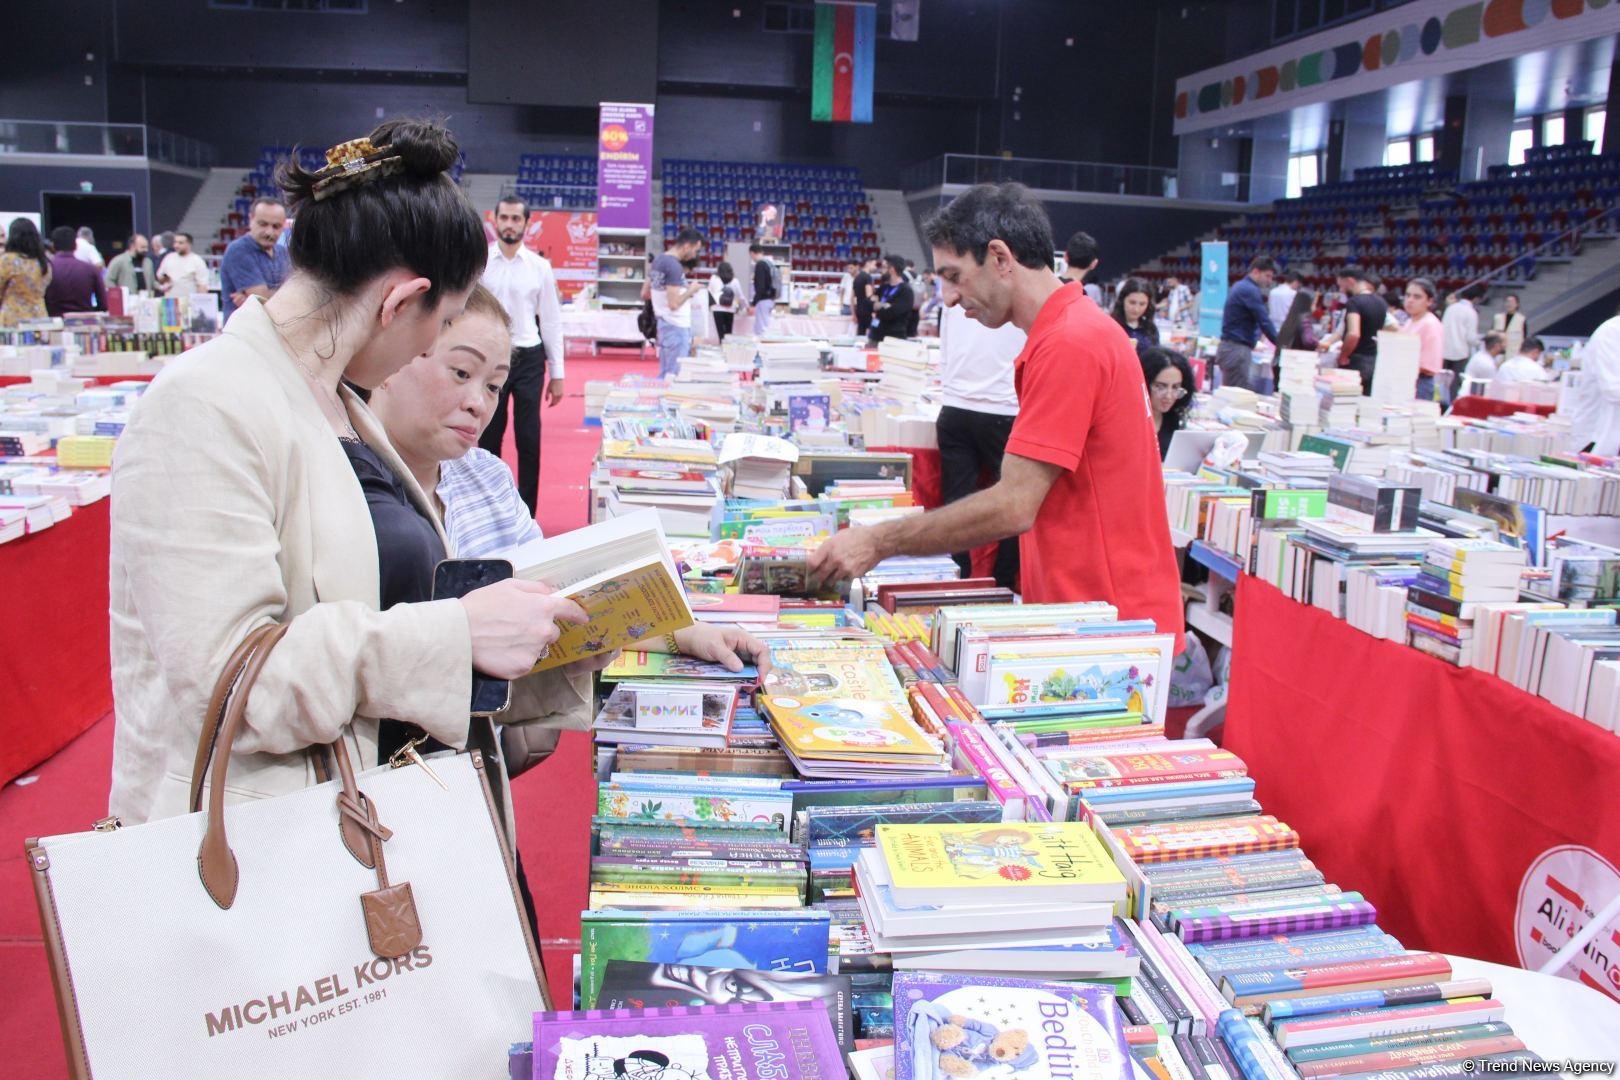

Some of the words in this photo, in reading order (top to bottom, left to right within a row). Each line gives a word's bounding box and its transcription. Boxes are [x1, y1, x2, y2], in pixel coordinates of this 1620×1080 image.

[639, 704, 698, 717] ТОМИК
[905, 833, 934, 874] ANIMALS
[1038, 852, 1093, 879] Haig
[204, 973, 349, 1037] MICHAEL
[354, 945, 433, 988] KORS
[268, 1021, 298, 1039] NEW
[300, 1008, 336, 1029] YORK
[338, 998, 361, 1015] EST.
[363, 987, 388, 1004] 1981
[743, 1024, 788, 1080] СЛАБ
